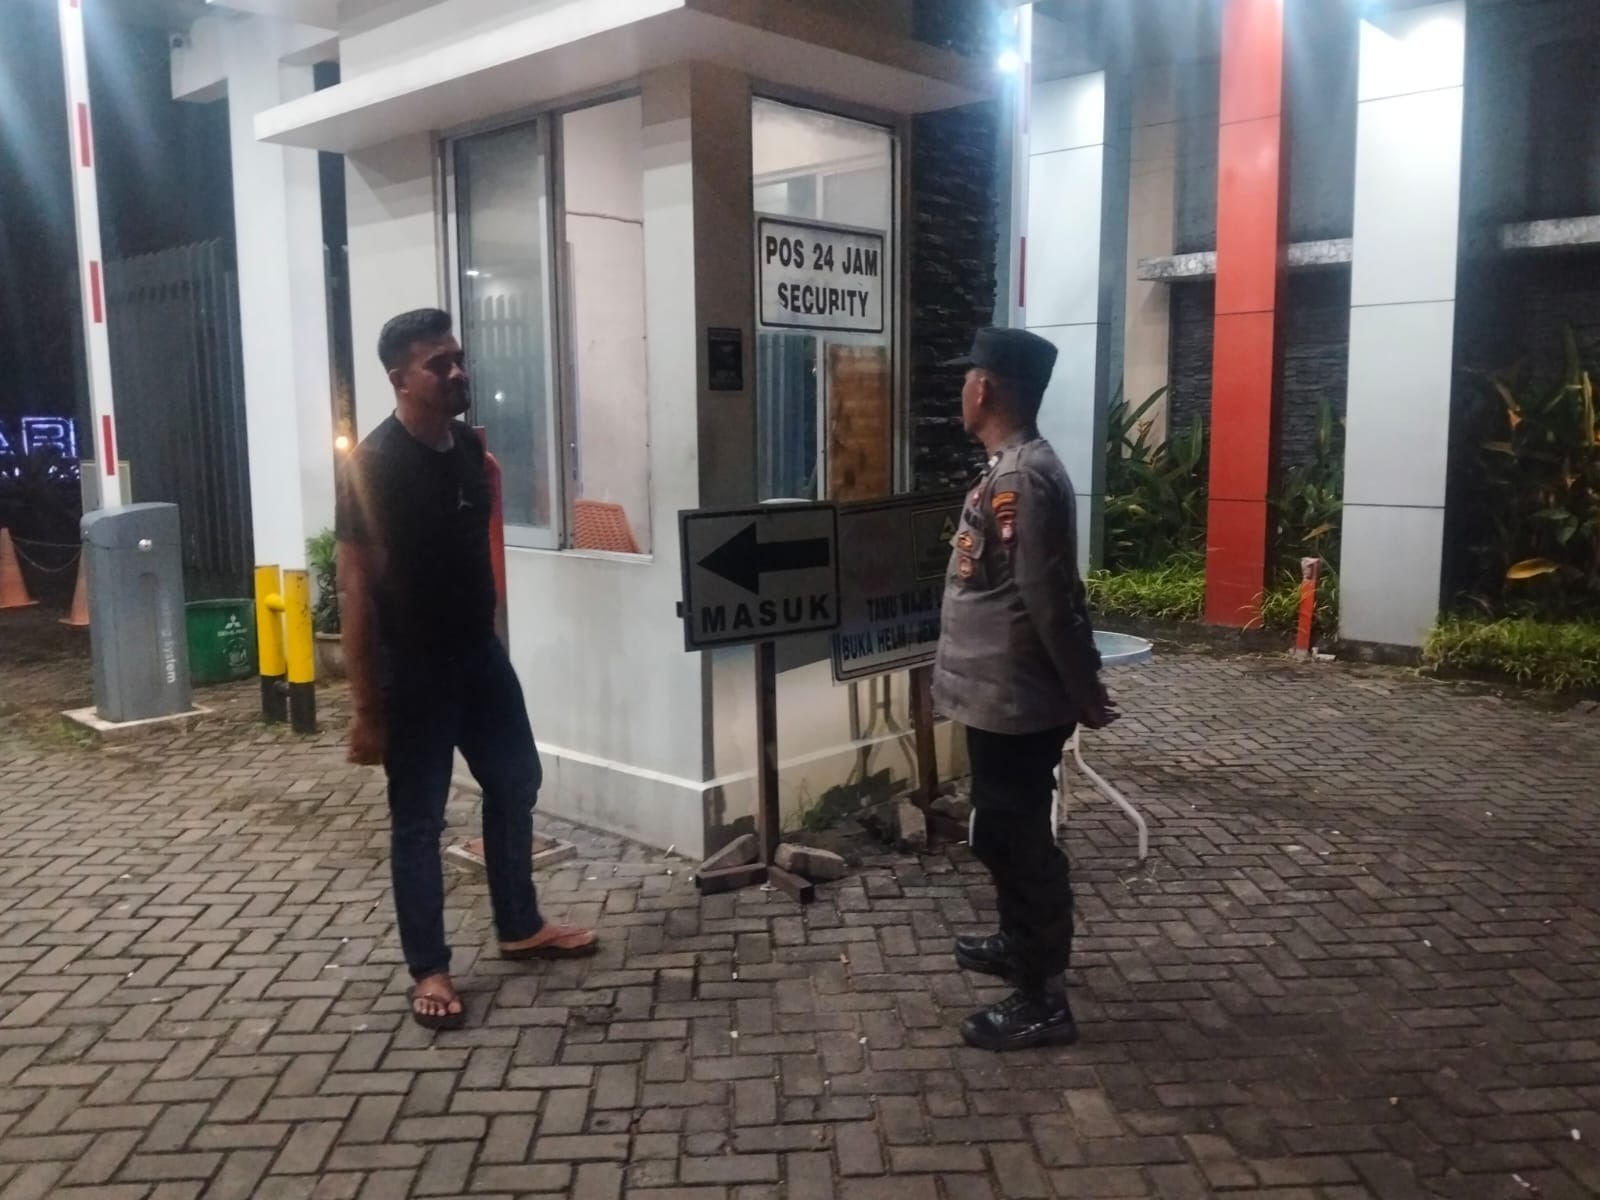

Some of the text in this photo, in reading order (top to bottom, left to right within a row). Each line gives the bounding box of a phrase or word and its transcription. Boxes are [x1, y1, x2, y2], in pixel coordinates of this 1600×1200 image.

[766, 236, 878, 277] POS 24 JAM
[777, 282, 869, 317] SECURITY
[701, 593, 832, 633] MASUK
[842, 631, 874, 660] BUKA
